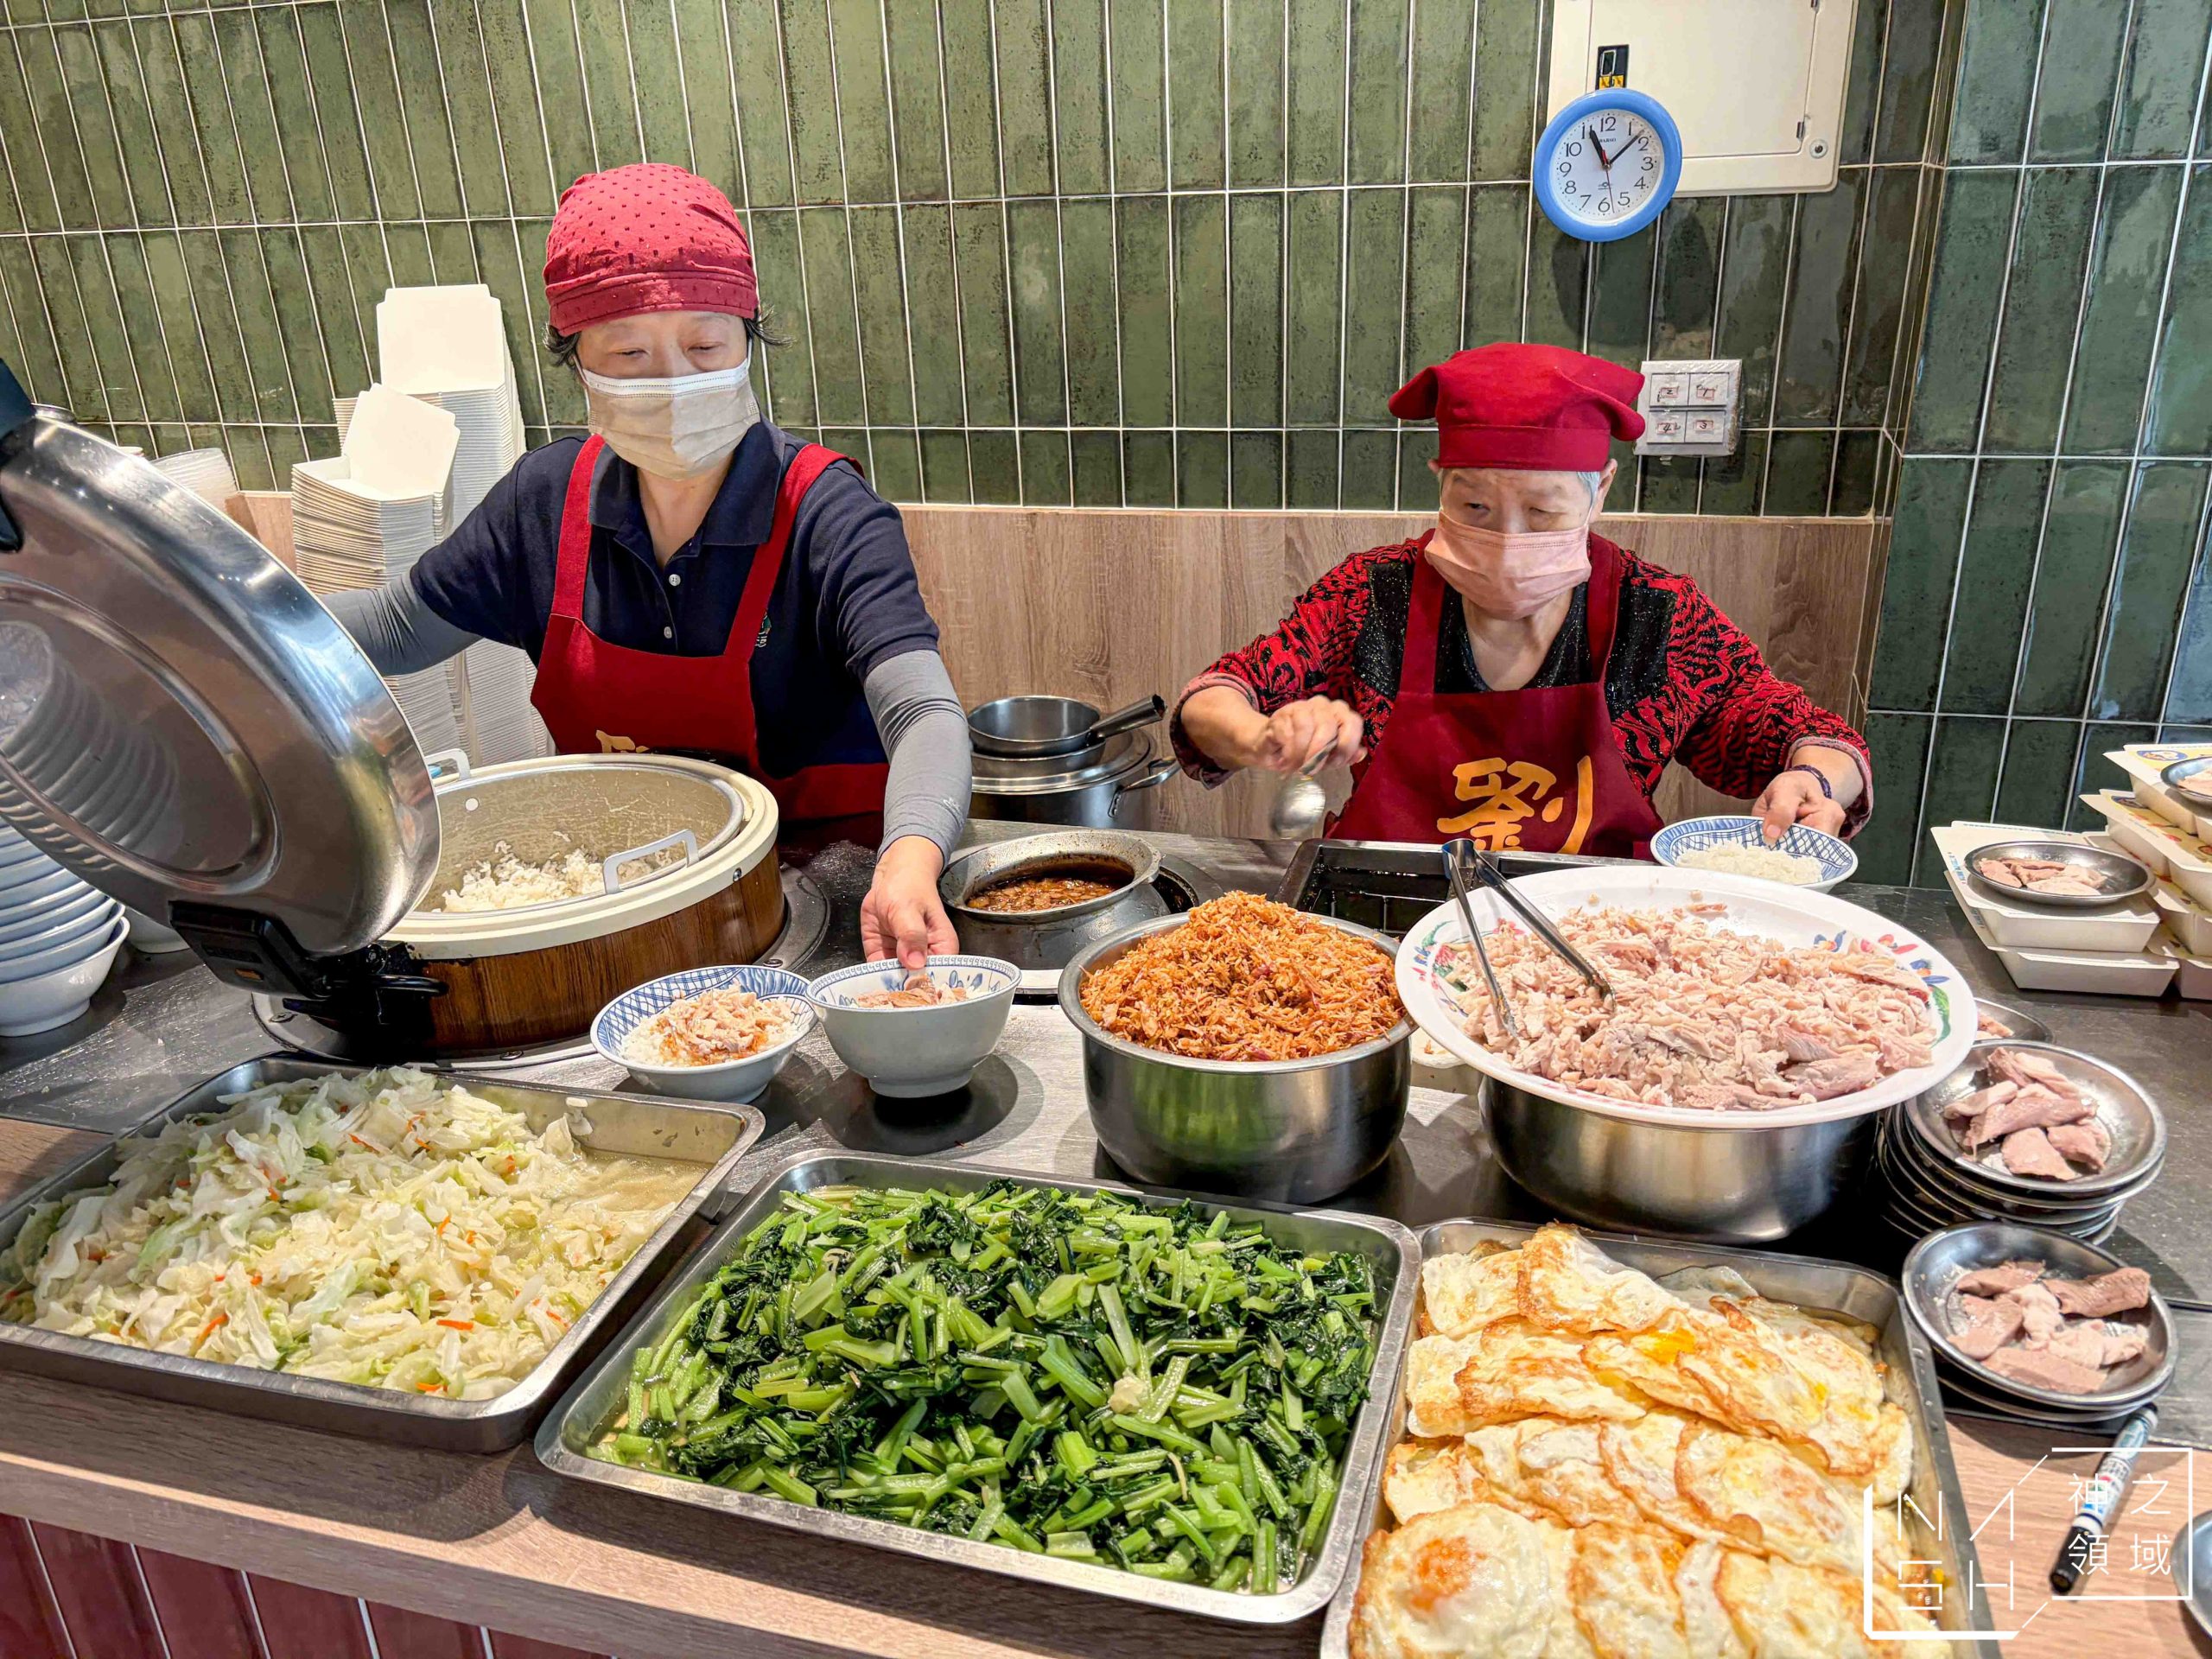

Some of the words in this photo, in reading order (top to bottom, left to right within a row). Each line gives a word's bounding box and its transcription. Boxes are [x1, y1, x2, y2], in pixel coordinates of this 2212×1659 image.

[1600, 117, 1617, 132] 12
[1566, 142, 1582, 157] 10
[1638, 137, 1649, 151] 2
[1559, 162, 1572, 177] 9
[1641, 156, 1654, 171] 3
[1565, 180, 1577, 194] 8
[1634, 176, 1646, 189] 4
[1580, 194, 1592, 208] 7
[1598, 197, 1611, 213] 6
[1618, 192, 1630, 206] 5
[1662, 423, 1672, 433] 4
